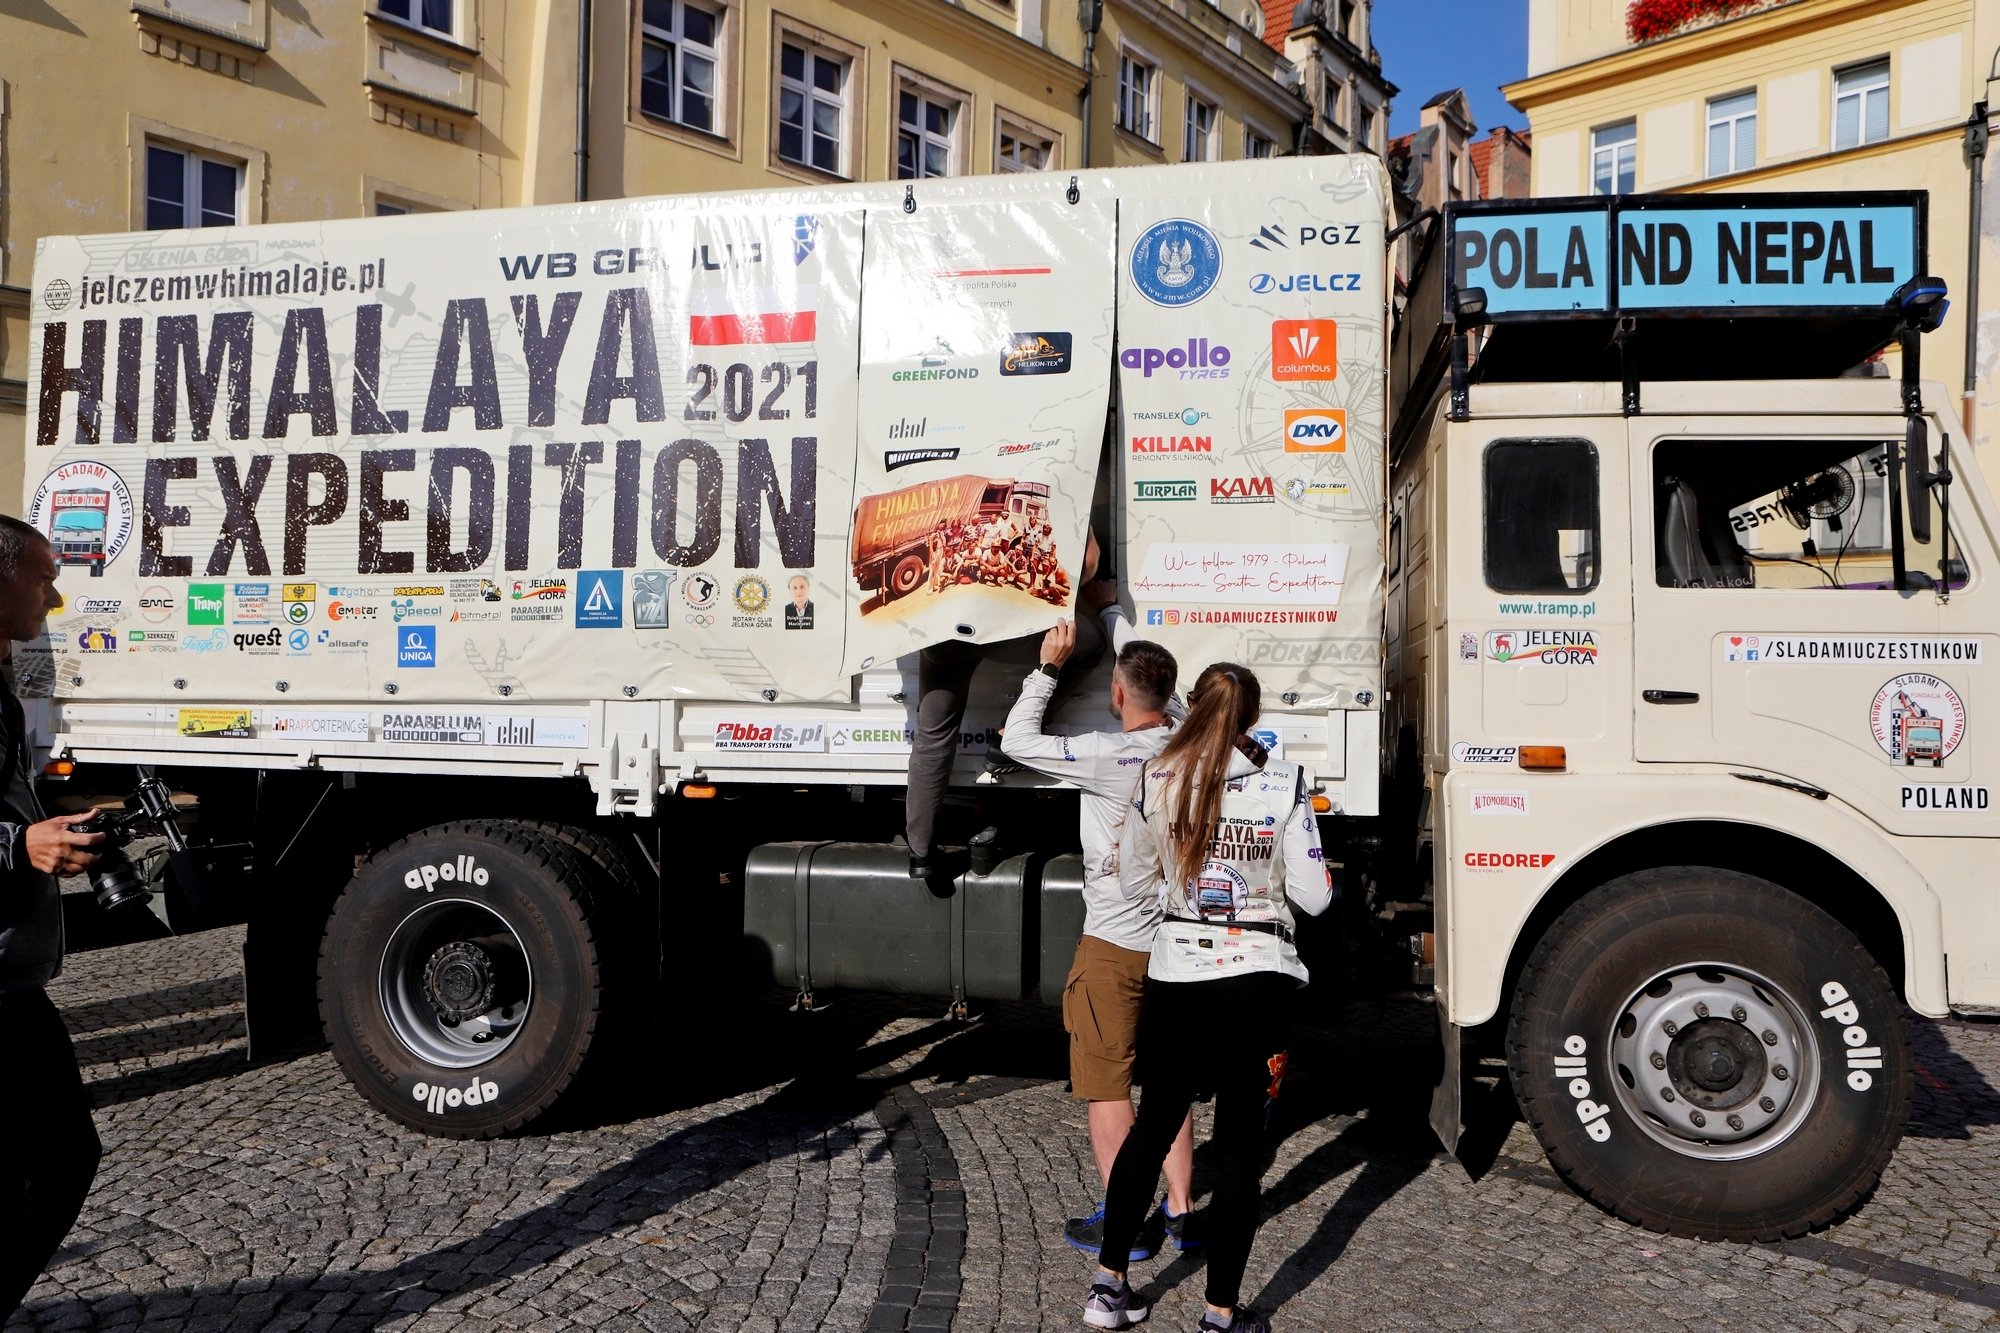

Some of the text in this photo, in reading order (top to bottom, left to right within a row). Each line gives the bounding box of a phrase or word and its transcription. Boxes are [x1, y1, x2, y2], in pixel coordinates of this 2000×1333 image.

[1136, 225, 1216, 263] AGENCJA MIENIA WOJSKOWEGO
[1301, 225, 1361, 246] PGZ
[130, 248, 197, 269] JELENIA
[1718, 220, 1895, 284] NEPAL
[500, 243, 762, 282] WB GRUP
[80, 258, 386, 309] jelczemwhimalaje.pl
[991, 280, 1017, 289] Polska
[1142, 275, 1211, 300] www.amw.com.pl
[1279, 273, 1361, 292] JELCZ
[37, 286, 665, 446] HIMALAYA
[1120, 338, 1231, 377] apollo
[892, 368, 979, 382] GREENFOND
[1179, 368, 1231, 380] TYRES
[1277, 363, 1331, 374] columbus
[684, 361, 817, 423] 2021
[889, 417, 927, 439] ekol
[1292, 424, 1340, 438] DKV
[1005, 438, 1061, 454] bbats.pl
[1132, 436, 1212, 453] KILIAN
[888, 449, 955, 466] Militaria.pl
[1132, 453, 1212, 462] REMONTY SILNIKÓW
[1135, 481, 1197, 498] TURPLAN
[1210, 477, 1274, 497] KAM
[31, 485, 49, 526] ROWICZ
[57, 496, 105, 505] EXPEDITION
[139, 437, 817, 577] EXPEDITION
[876, 482, 960, 521] HIMALAYA
[873, 504, 962, 544] EXPEDITION
[1165, 551, 1326, 573] We follow 1979 Poland
[238, 586, 266, 594] Fristom
[529, 579, 566, 588] JELENIA
[681, 577, 691, 595] MUZEUM
[1134, 572, 1345, 594] Annapurna South Expedition
[189, 596, 222, 619] Tramp
[511, 606, 563, 614] PARABELLUM
[1184, 610, 1338, 624] /SLADAMIUCZESTNIKOW
[1499, 602, 1595, 618] www.tramp.pl
[234, 628, 282, 651] quest
[1523, 631, 1594, 647] JELENIA
[400, 652, 432, 661] UNIQA
[1253, 641, 1378, 663] POKHARA
[1541, 647, 1594, 665] GÓRA
[1765, 641, 1978, 660] /SLADAMIUCZESTNIKOW
[383, 714, 481, 730] PARABELLUM
[1872, 690, 1889, 741] PIETROWICZ
[289, 718, 368, 734] RAPPORTERING.se
[383, 730, 438, 741] STUDIO
[498, 717, 534, 745] ekol
[731, 724, 822, 745] bbats.pl
[1117, 757, 1143, 766] apollo
[1151, 770, 1175, 779] apollo
[1474, 795, 1525, 811] AUTOMOBILISTA
[1902, 787, 1988, 809] POLAND
[1229, 818, 1264, 826] GROUP
[1203, 842, 1273, 861] PEDITION
[1465, 853, 1540, 868] GEDORE
[404, 855, 490, 892] apollo
[1820, 981, 1882, 1092] apollo
[412, 1076, 499, 1114] apollo
[1554, 1034, 1612, 1143] apollo
